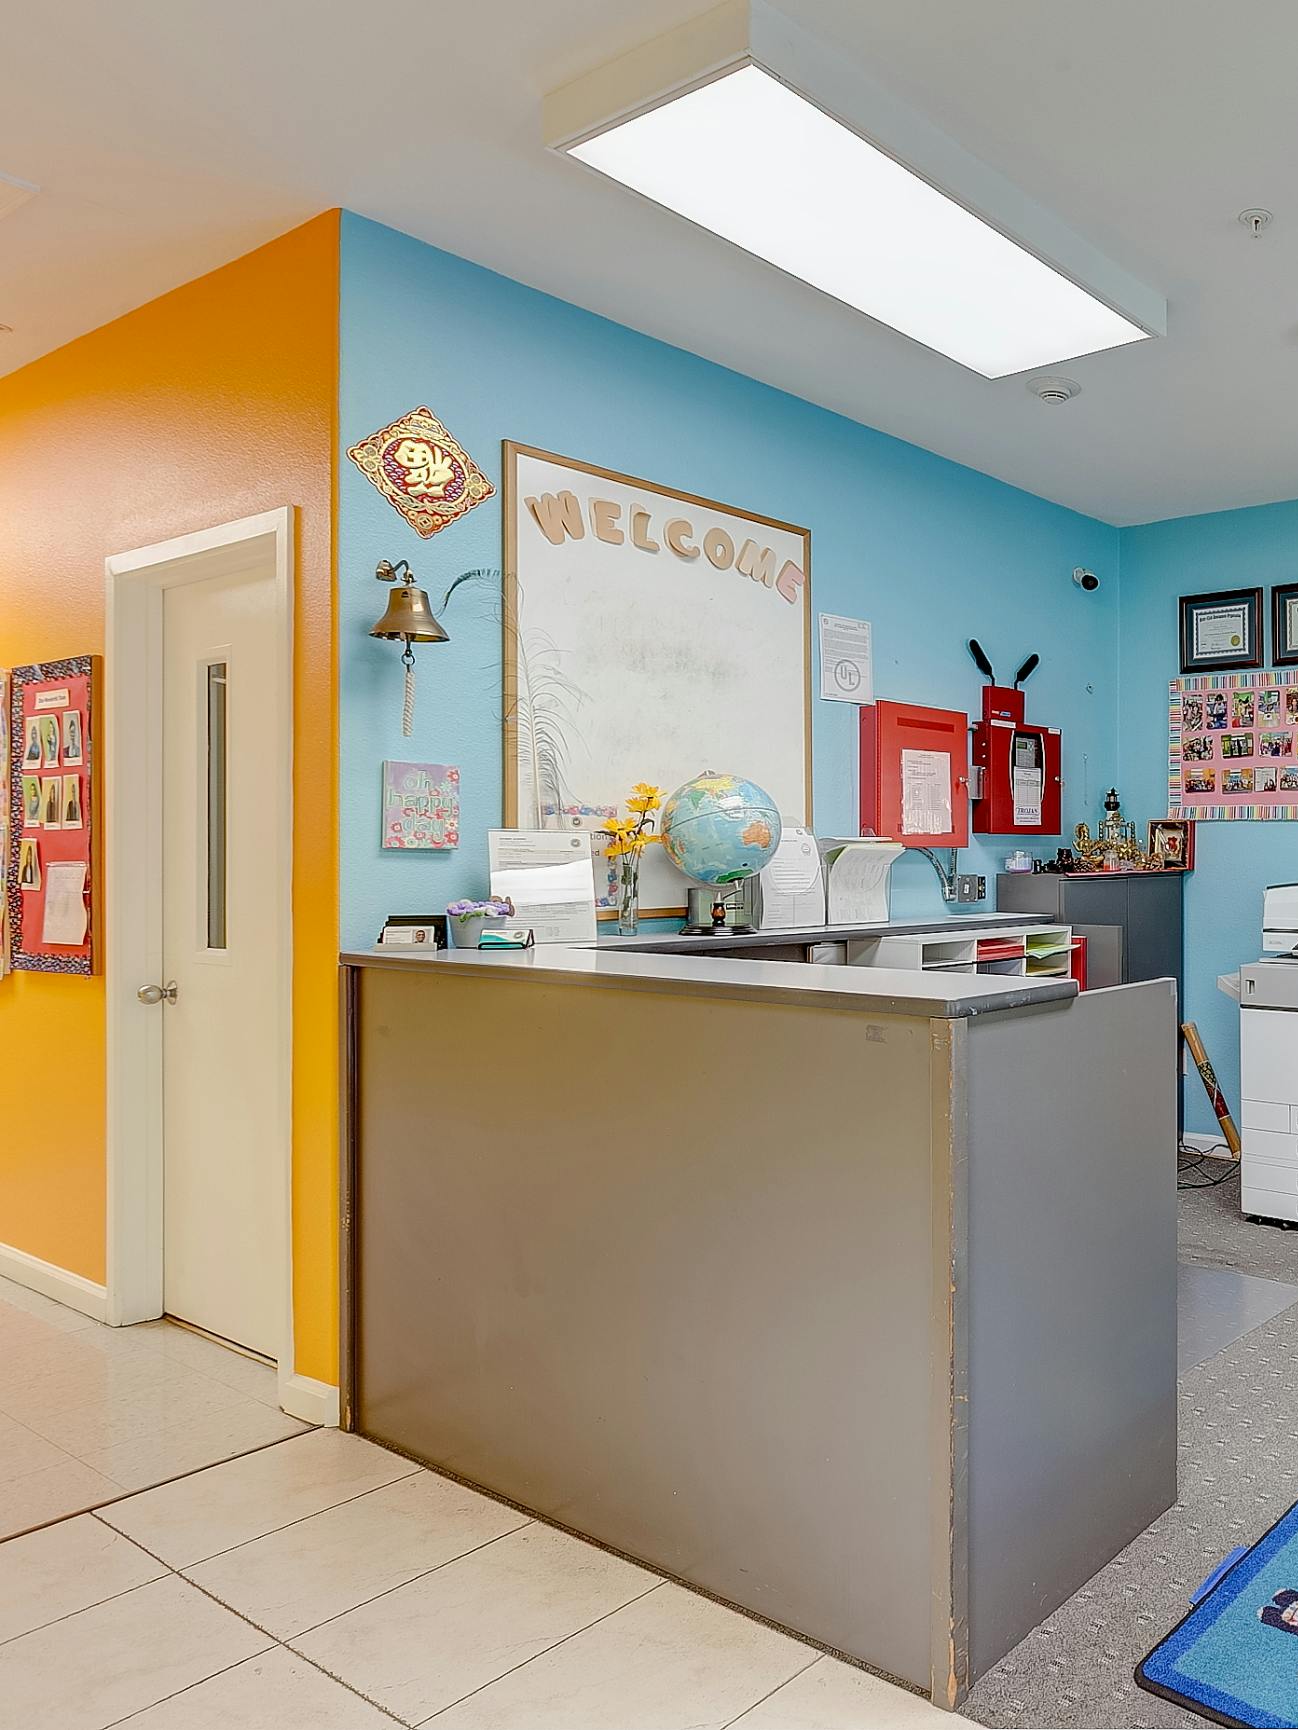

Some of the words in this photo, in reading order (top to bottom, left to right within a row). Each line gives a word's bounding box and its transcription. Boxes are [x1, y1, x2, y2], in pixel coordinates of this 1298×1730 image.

[524, 490, 805, 604] WELCOME
[840, 665, 855, 686] UL
[386, 785, 454, 818] happy
[403, 812, 446, 843] day
